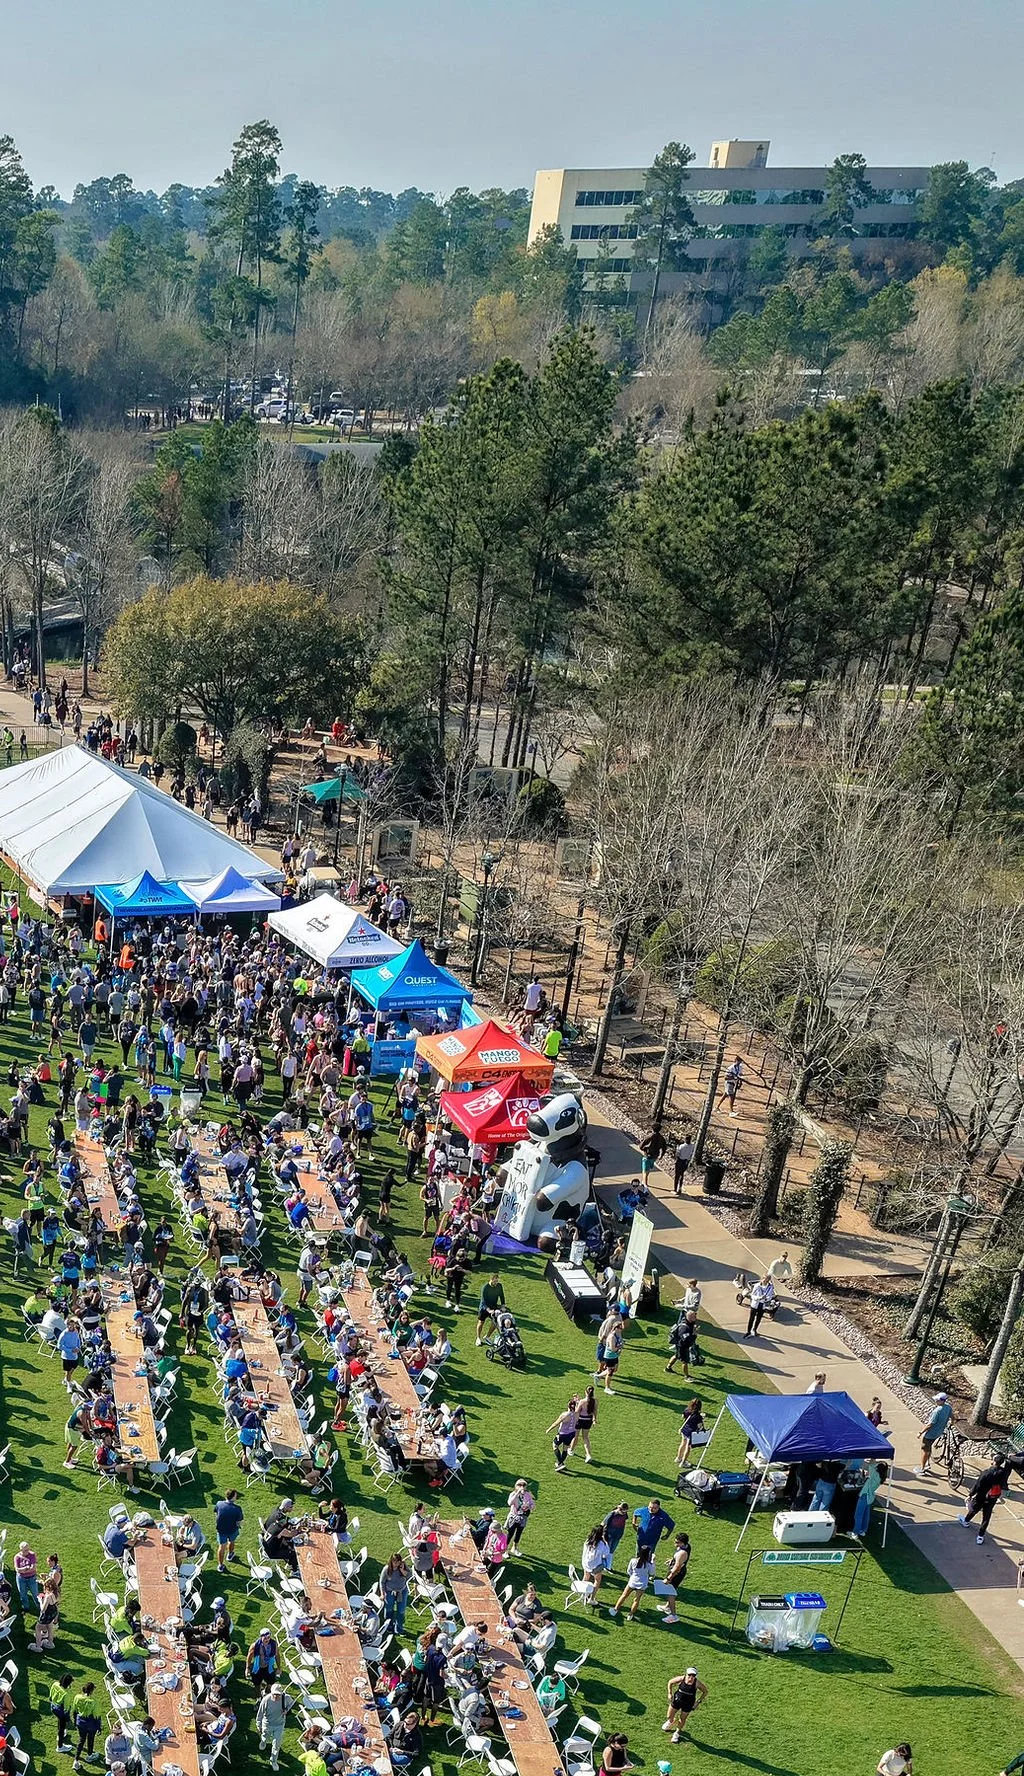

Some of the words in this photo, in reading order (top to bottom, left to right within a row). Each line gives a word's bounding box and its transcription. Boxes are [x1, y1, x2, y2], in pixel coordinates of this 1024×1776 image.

[350, 956, 364, 964] ZERO
[405, 976, 438, 985] QUEST
[480, 1050, 519, 1058] MANGO
[481, 1070, 501, 1079] C4
[514, 1157, 532, 1176] EAT
[507, 1179, 529, 1200] MOR
